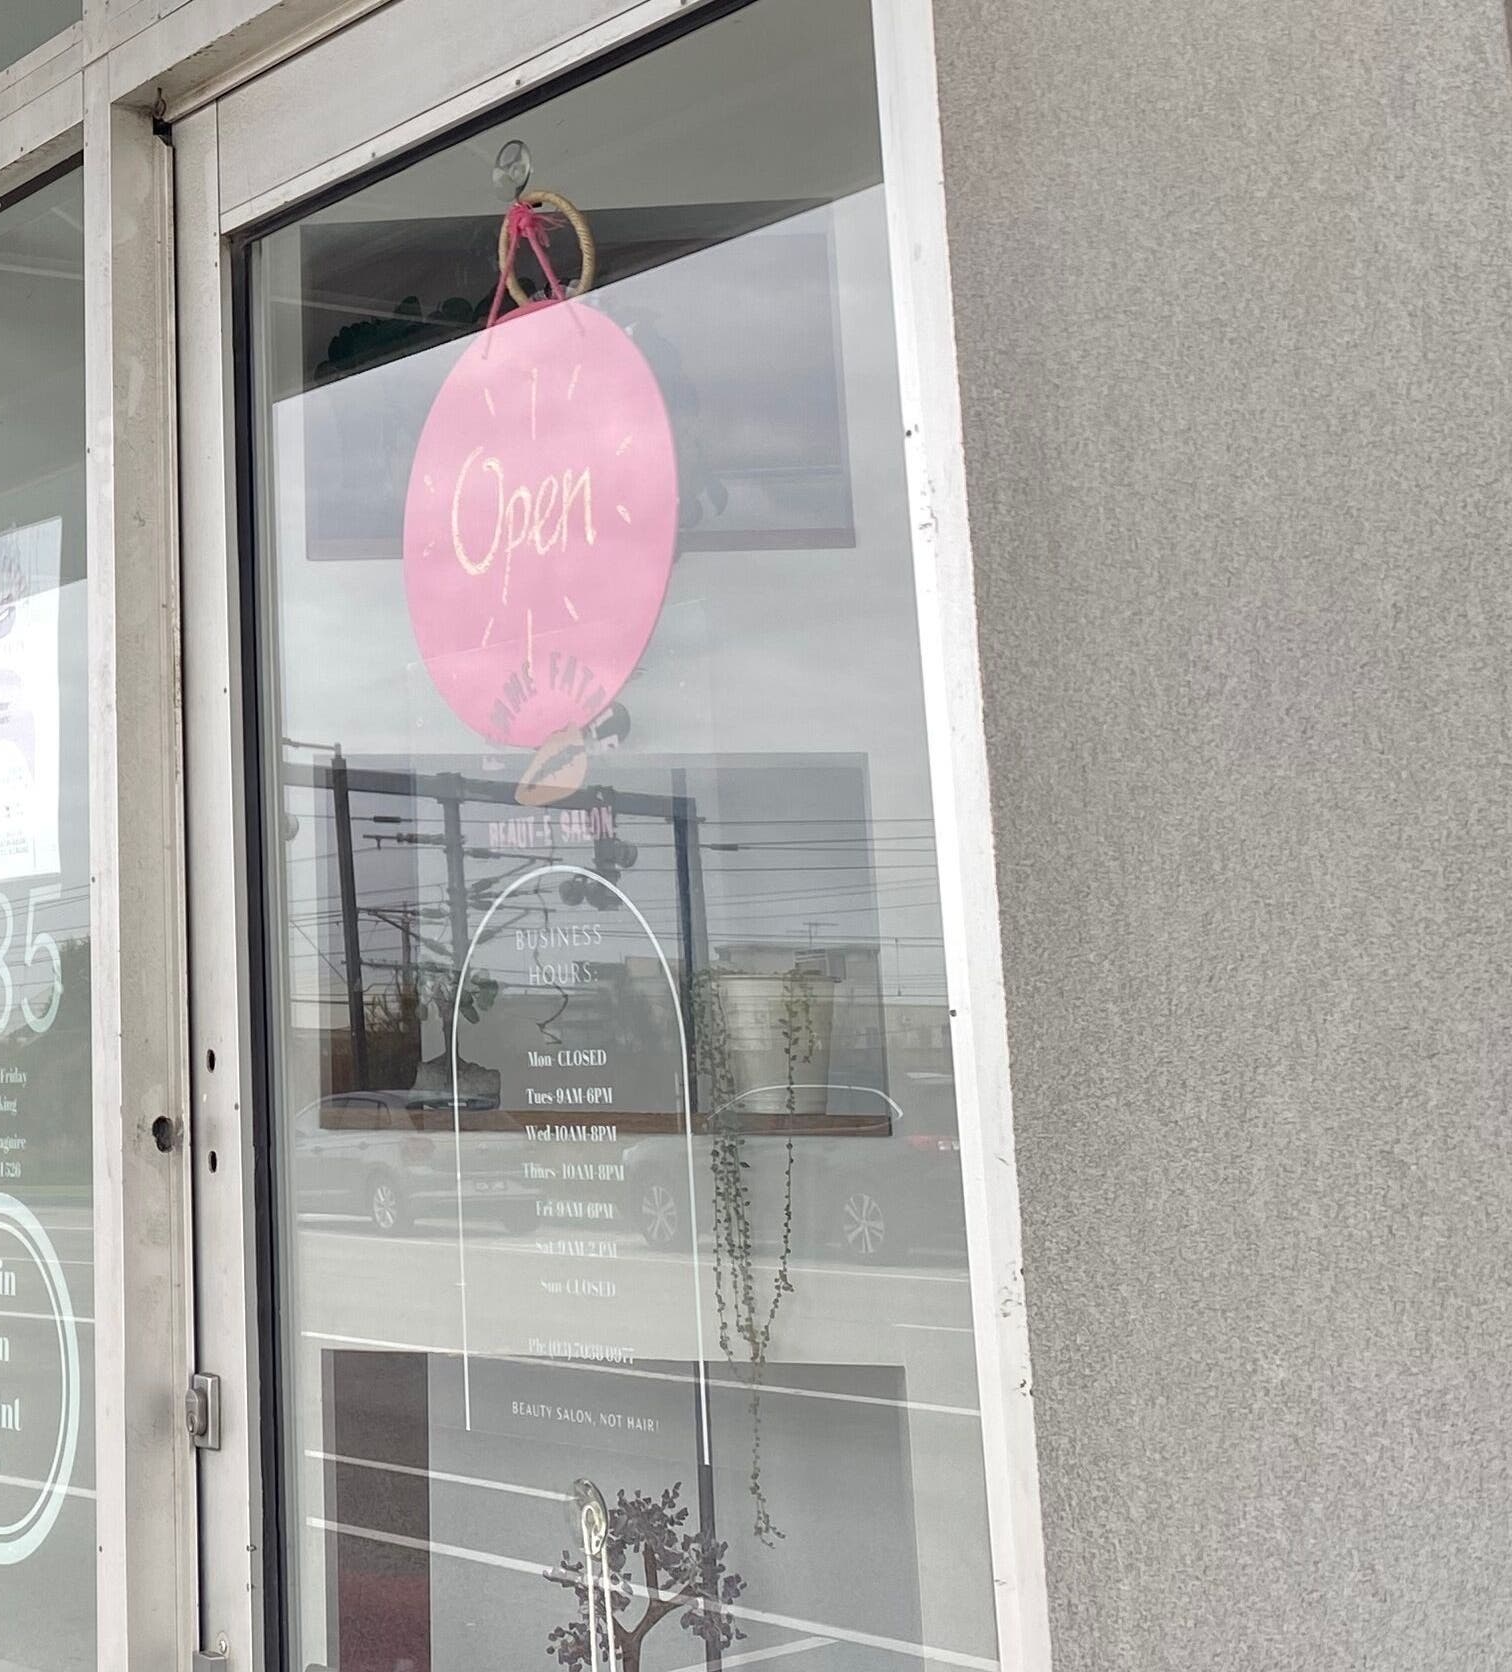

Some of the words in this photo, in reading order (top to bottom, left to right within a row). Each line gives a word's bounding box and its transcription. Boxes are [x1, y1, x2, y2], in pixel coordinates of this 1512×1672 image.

[452, 446, 595, 606] Open
[516, 924, 603, 951] BUSINESS
[529, 962, 599, 985] HOURS:
[557, 1049, 607, 1067] CLOSED
[0, 1066, 27, 1088] Friday
[512, 1401, 553, 1418] BEAUTY
[556, 1406, 596, 1427] SALON,
[599, 1412, 622, 1428] NOT
